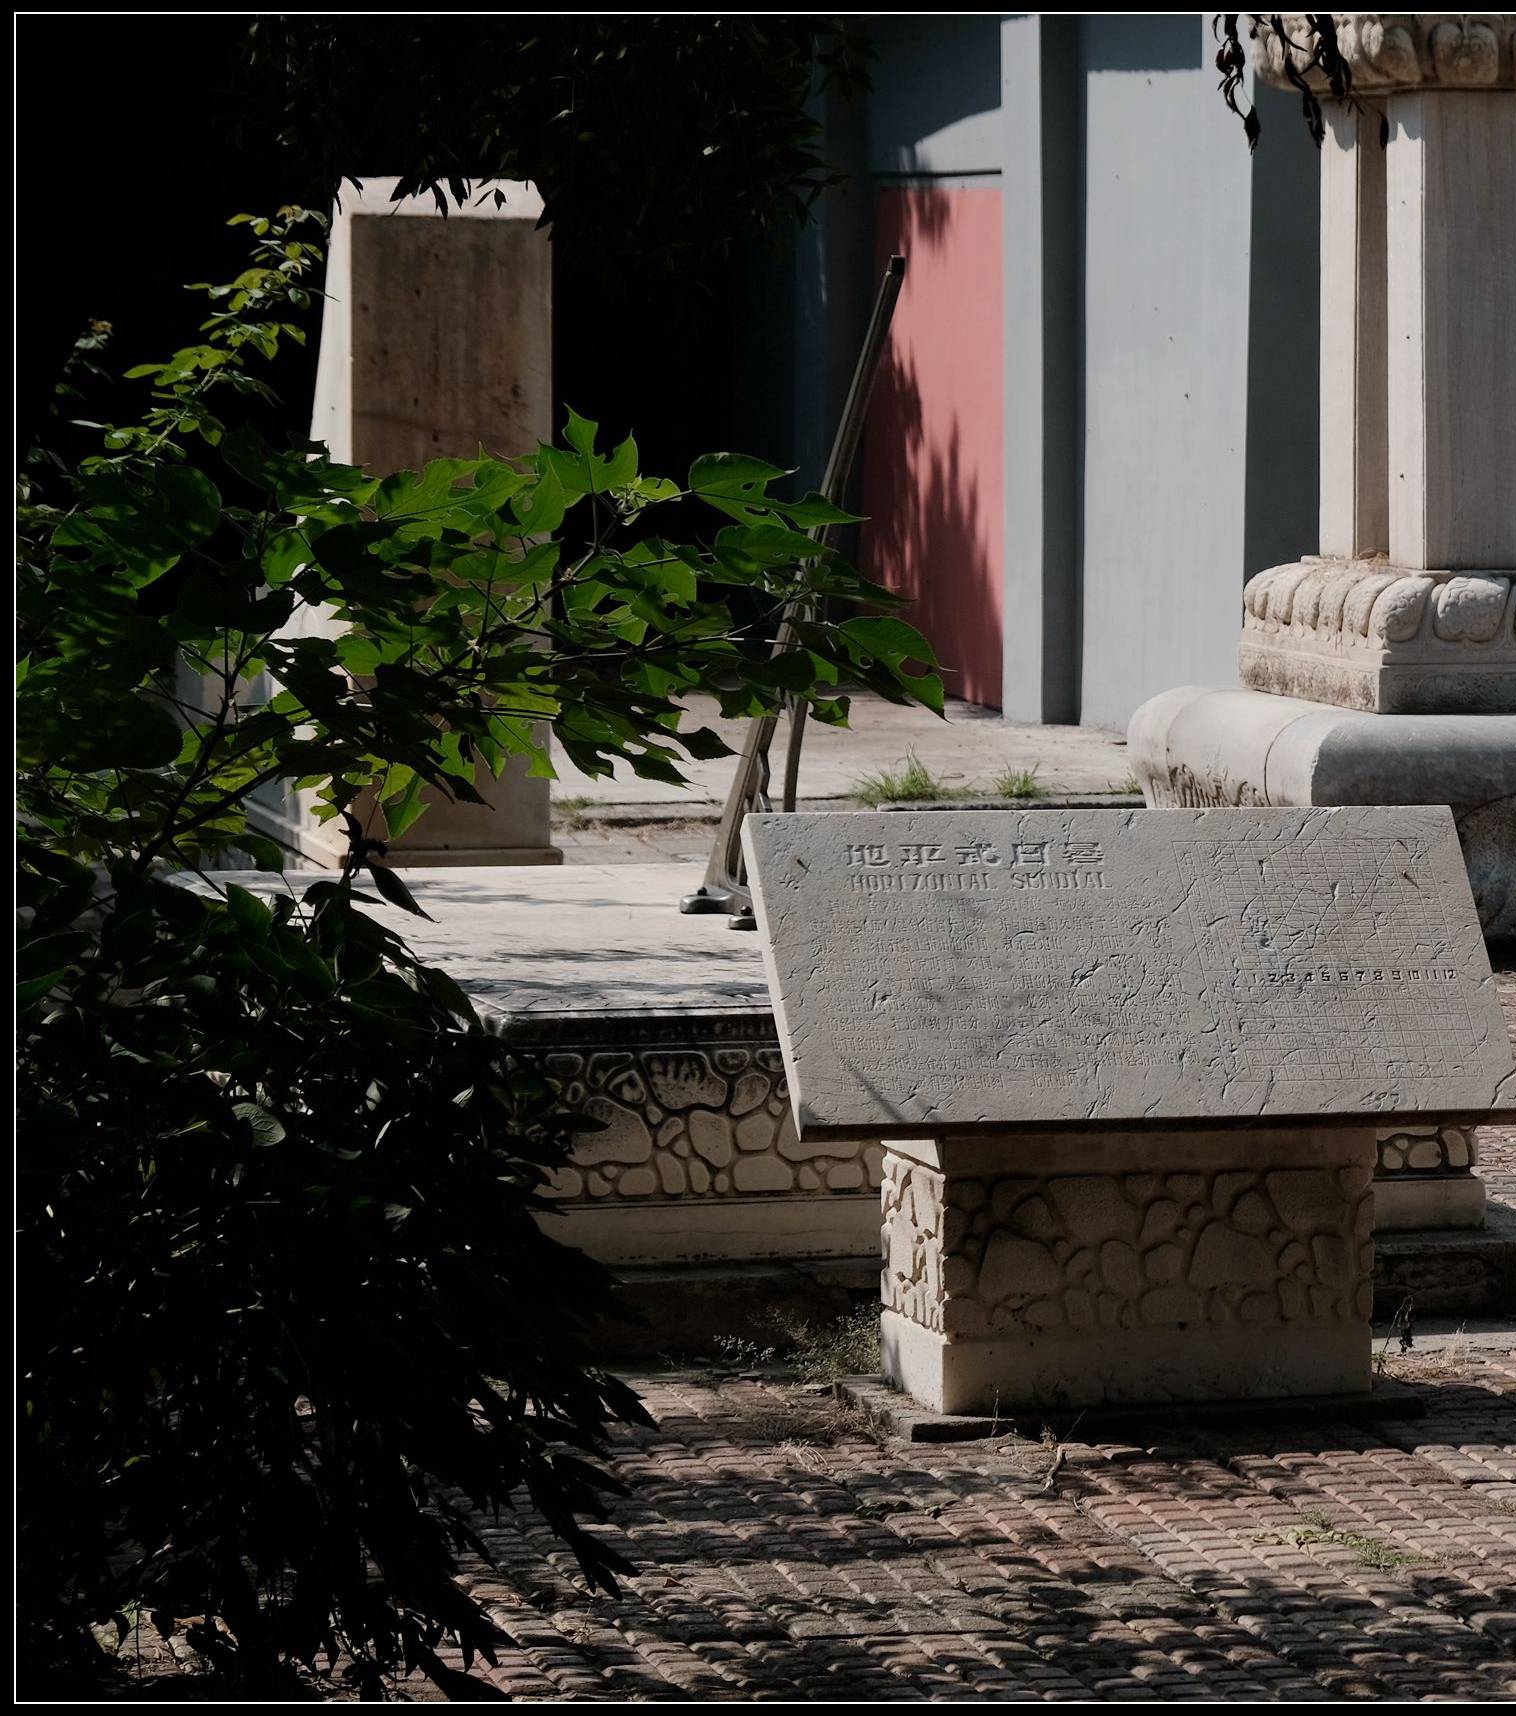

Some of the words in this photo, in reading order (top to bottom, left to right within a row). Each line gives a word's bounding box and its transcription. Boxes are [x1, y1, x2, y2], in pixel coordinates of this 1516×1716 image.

[850, 872, 1000, 891] HORIZONTAL
[1010, 870, 1113, 890] SUNDIAL
[1268, 973, 1279, 983] 2
[1304, 972, 1315, 983] 4
[1321, 971, 1331, 982] 5
[1339, 971, 1349, 982] 6
[1355, 970, 1365, 982] 7
[1374, 970, 1384, 981] 8
[1391, 970, 1401, 981] 9
[1408, 970, 1421, 981] 10
[1425, 969, 1439, 981] 11
[1443, 969, 1457, 981] 12
